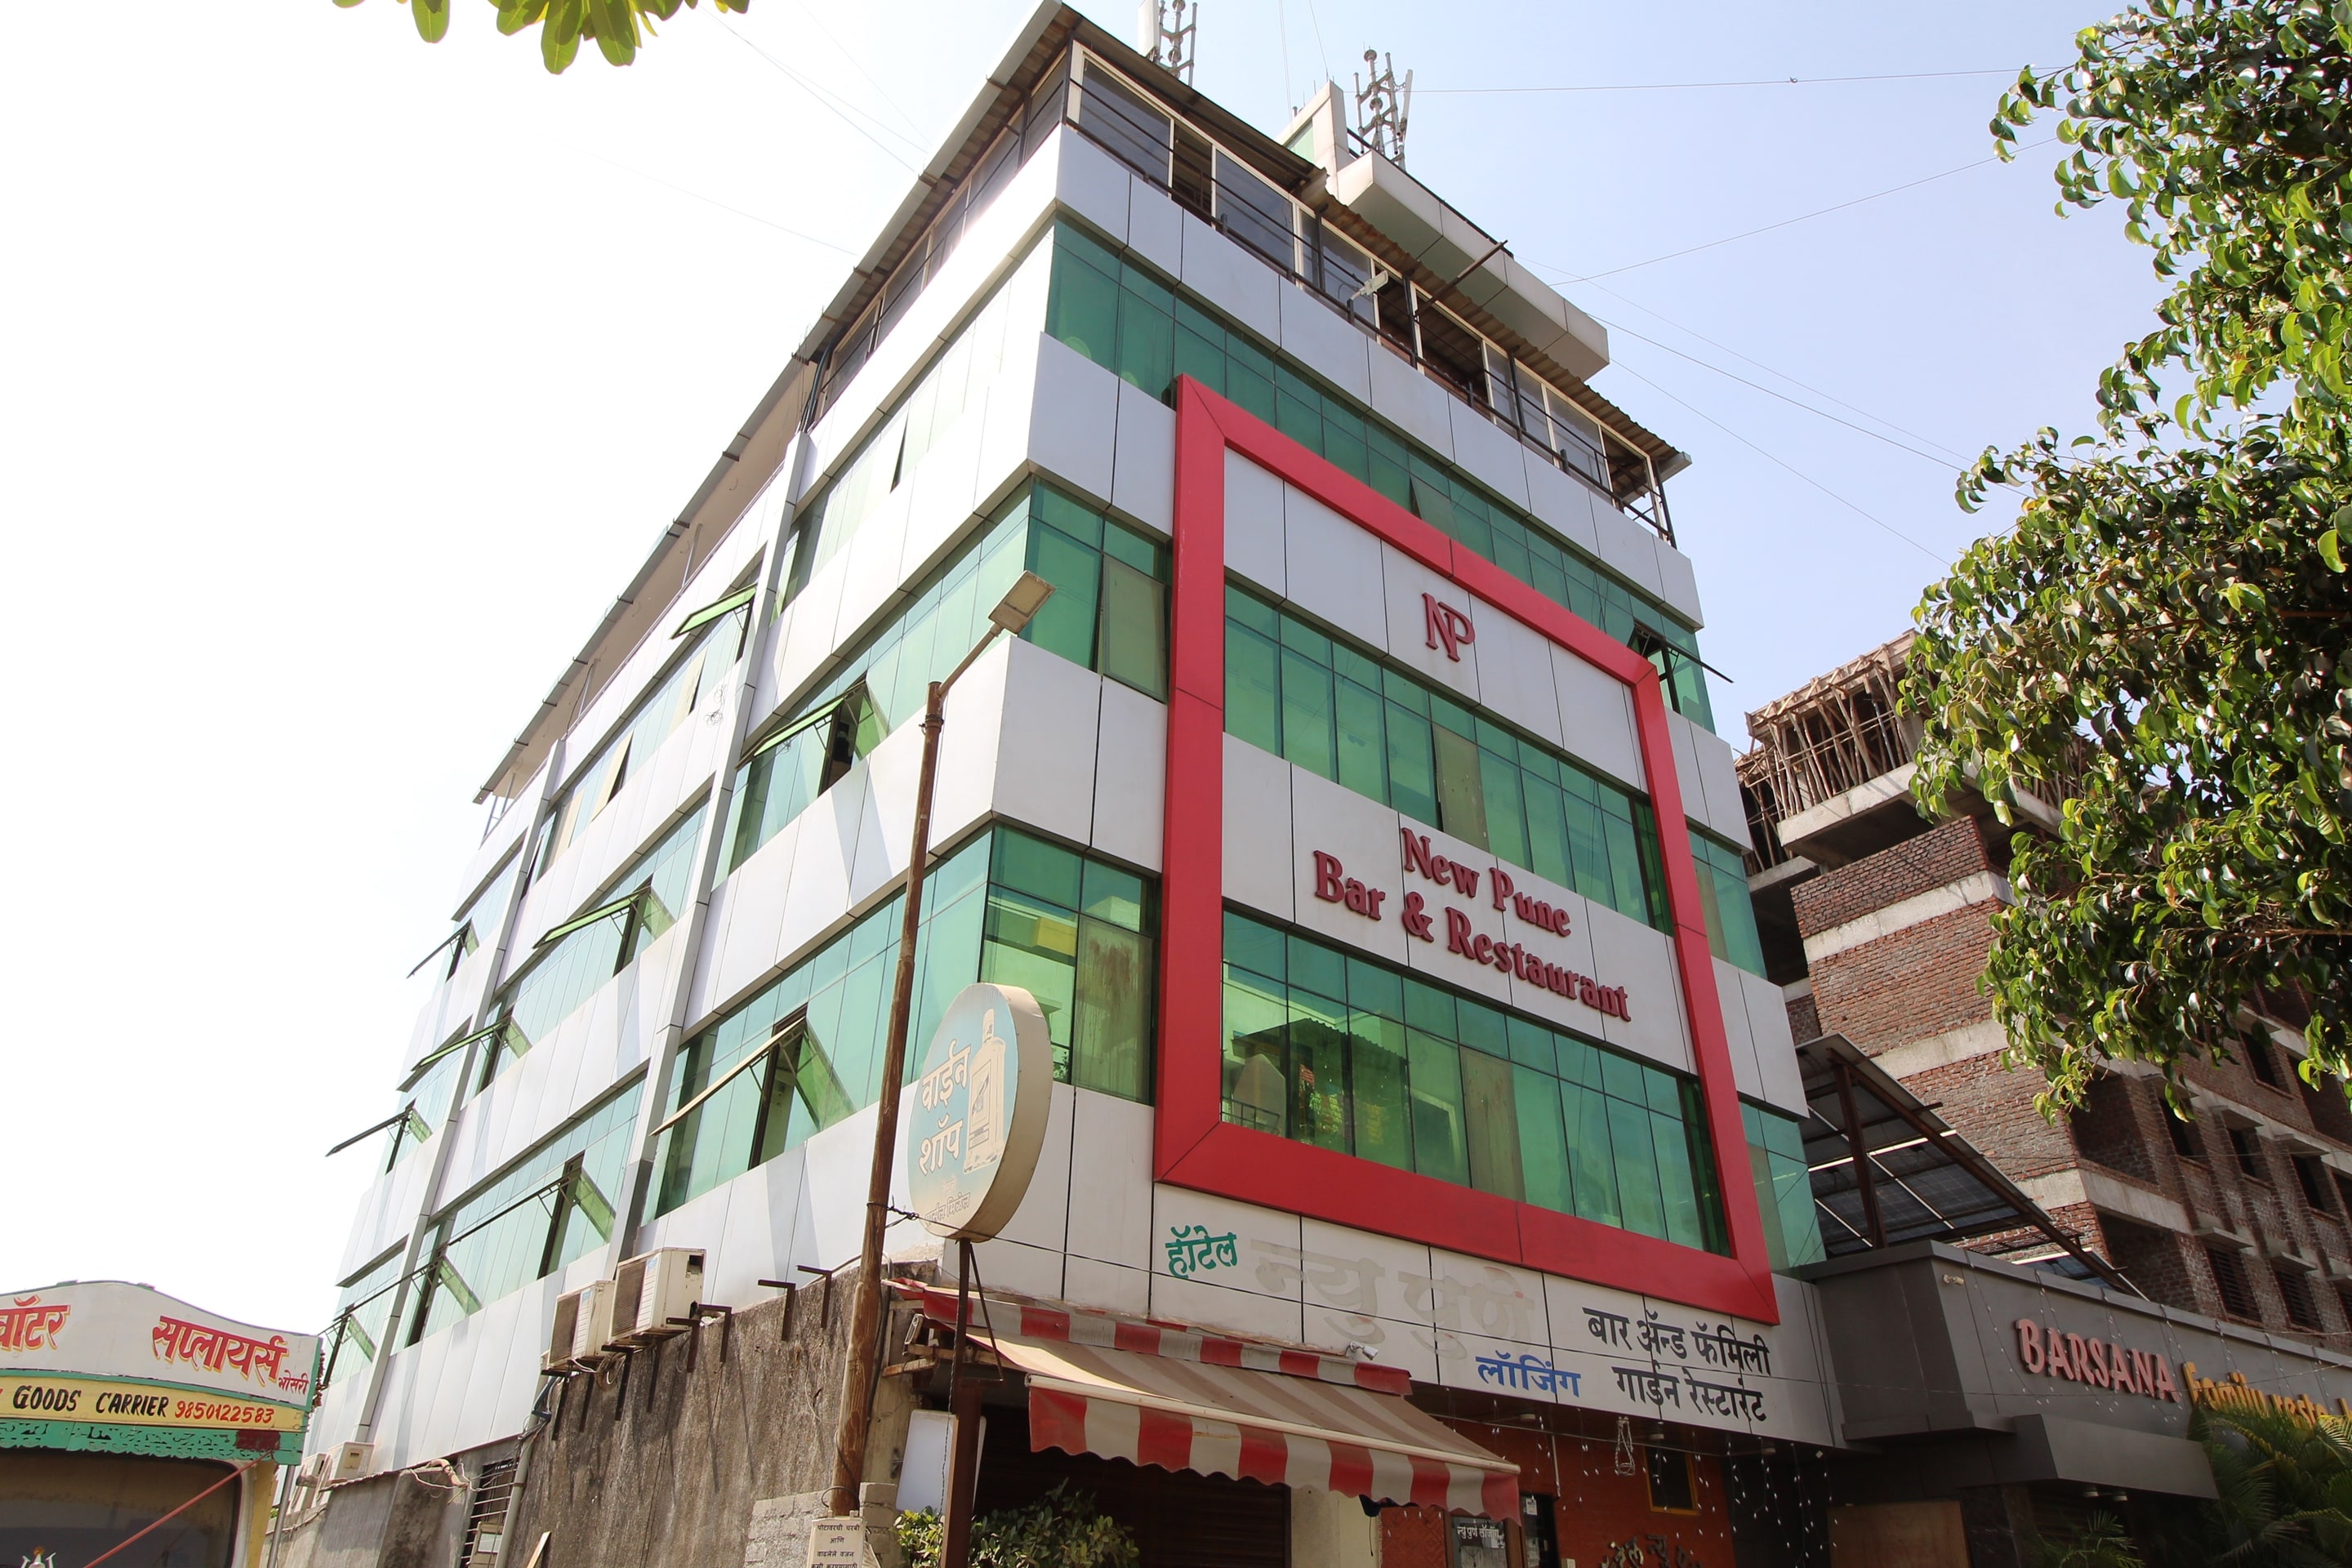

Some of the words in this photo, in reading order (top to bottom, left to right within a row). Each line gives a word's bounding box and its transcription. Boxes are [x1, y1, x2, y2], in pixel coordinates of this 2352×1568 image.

[1401, 826, 1480, 898] New
[1489, 866, 1571, 938] Pune
[1314, 850, 1386, 920] Bar
[1401, 891, 1434, 943] &
[1445, 906, 1631, 1022] Restaurant
[921, 1039, 971, 1112] वाईन
[919, 1114, 964, 1176] शॉप
[1165, 1225, 1238, 1280] हॉटेल
[0, 1294, 71, 1352] वॉटर
[152, 1315, 289, 1387] सप्लायर्स
[1475, 1349, 1582, 1398] लॉजिंग
[1582, 1307, 1633, 1350] बार
[1690, 1321, 1771, 1377] फॅमिली
[2016, 1318, 2184, 1403] BARSANA
[12, 1383, 82, 1412] GOODS
[96, 1392, 170, 1418] CARRIER
[174, 1400, 276, 1424] 9850122583
[1611, 1359, 1681, 1410] गार्डन
